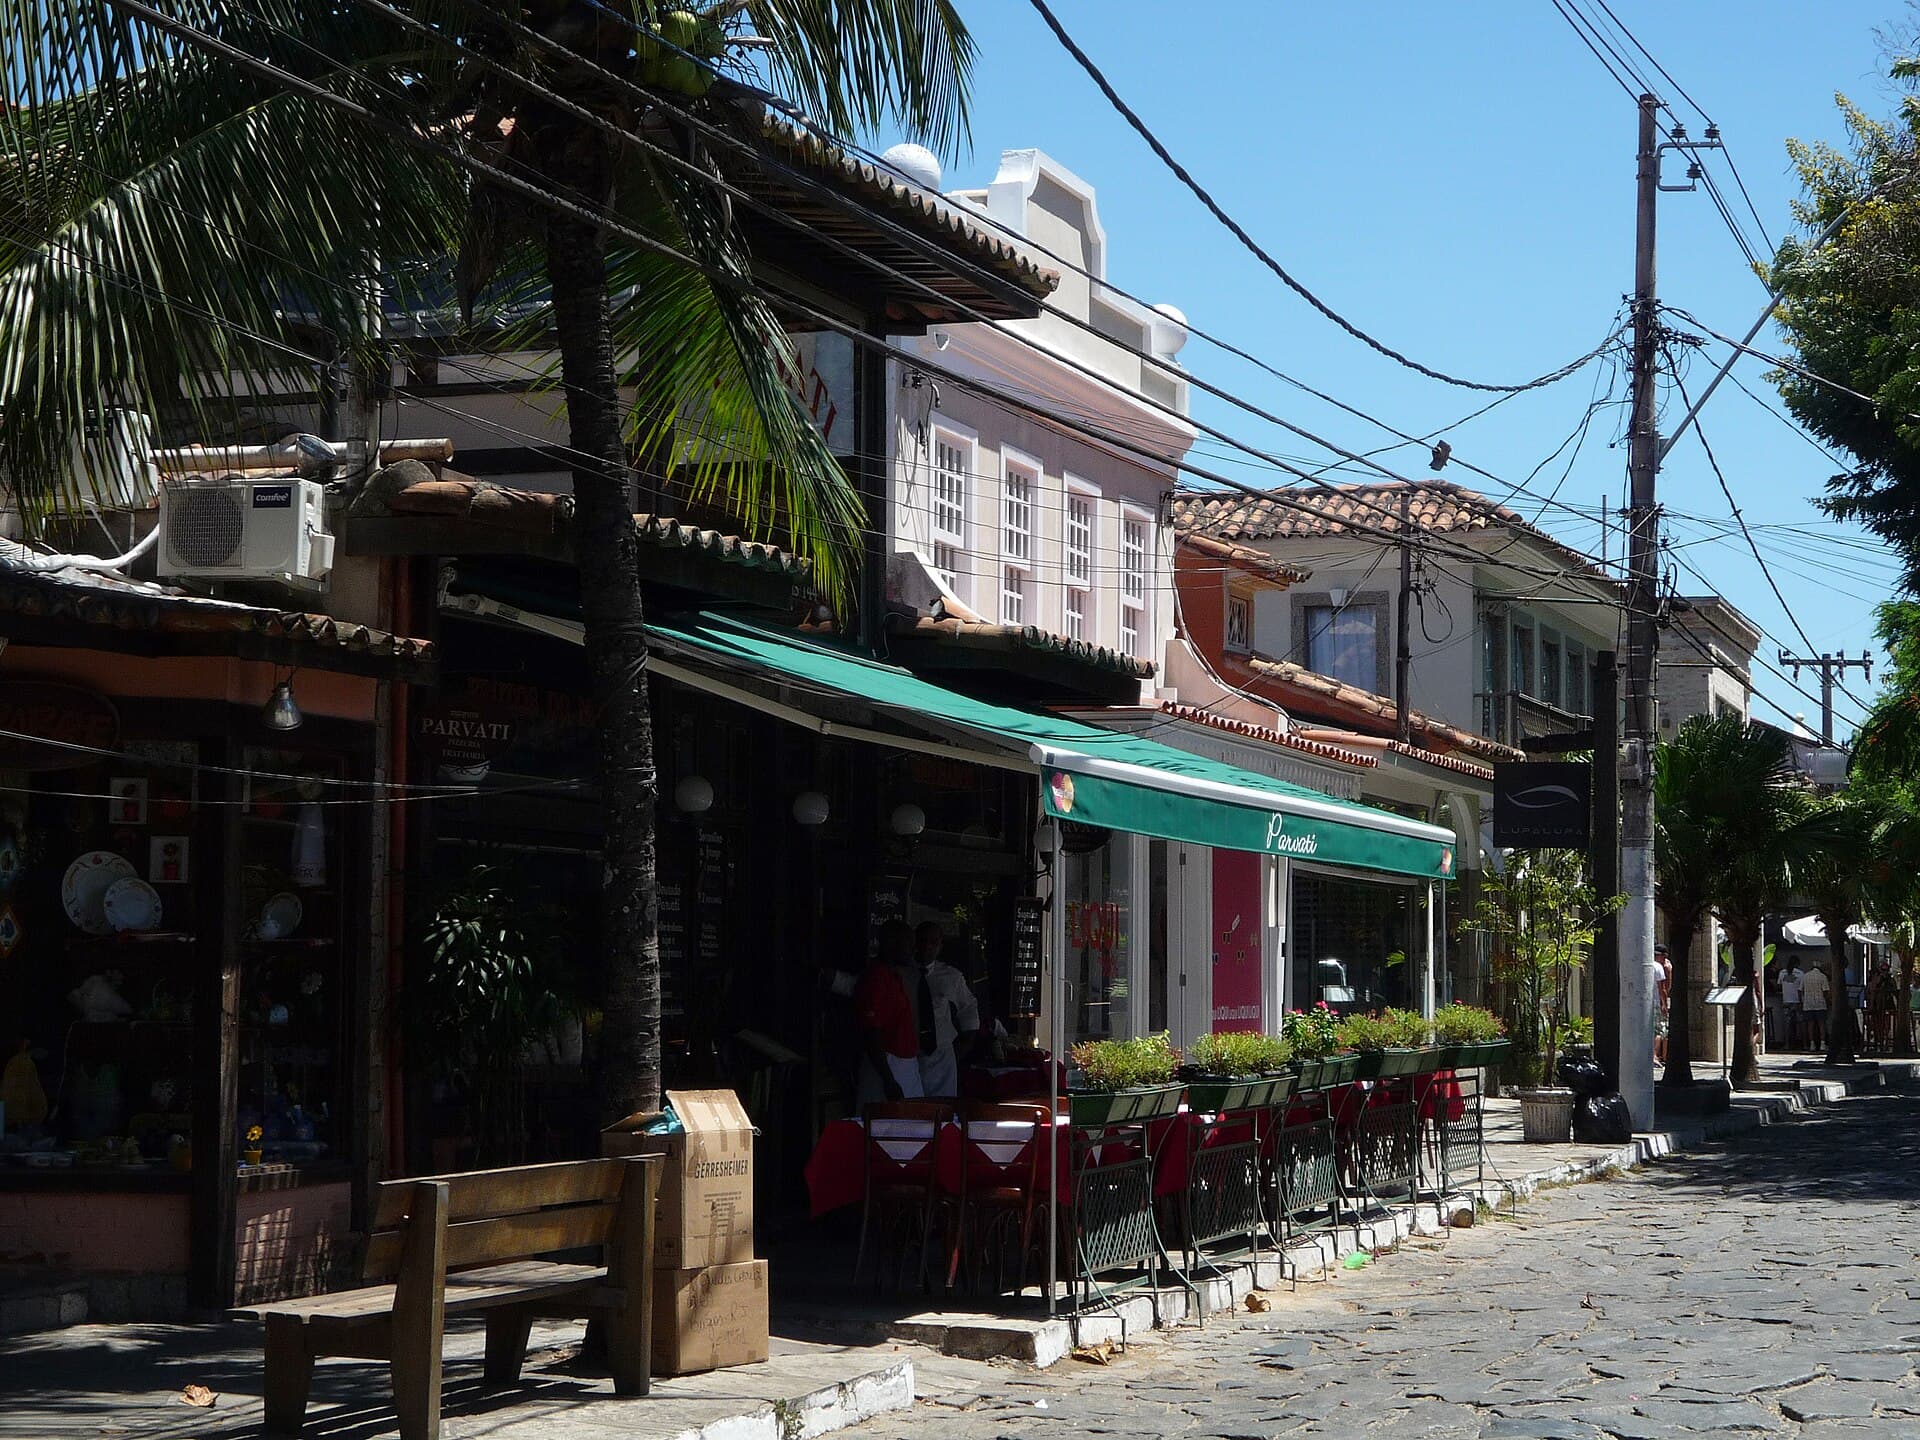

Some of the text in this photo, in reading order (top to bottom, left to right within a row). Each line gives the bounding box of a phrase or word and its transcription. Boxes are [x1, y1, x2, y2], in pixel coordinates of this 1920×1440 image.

[420, 717, 511, 740] PARVATI
[1266, 811, 1318, 854] Parvati
[694, 1153, 748, 1179] GERRESHEIMER
